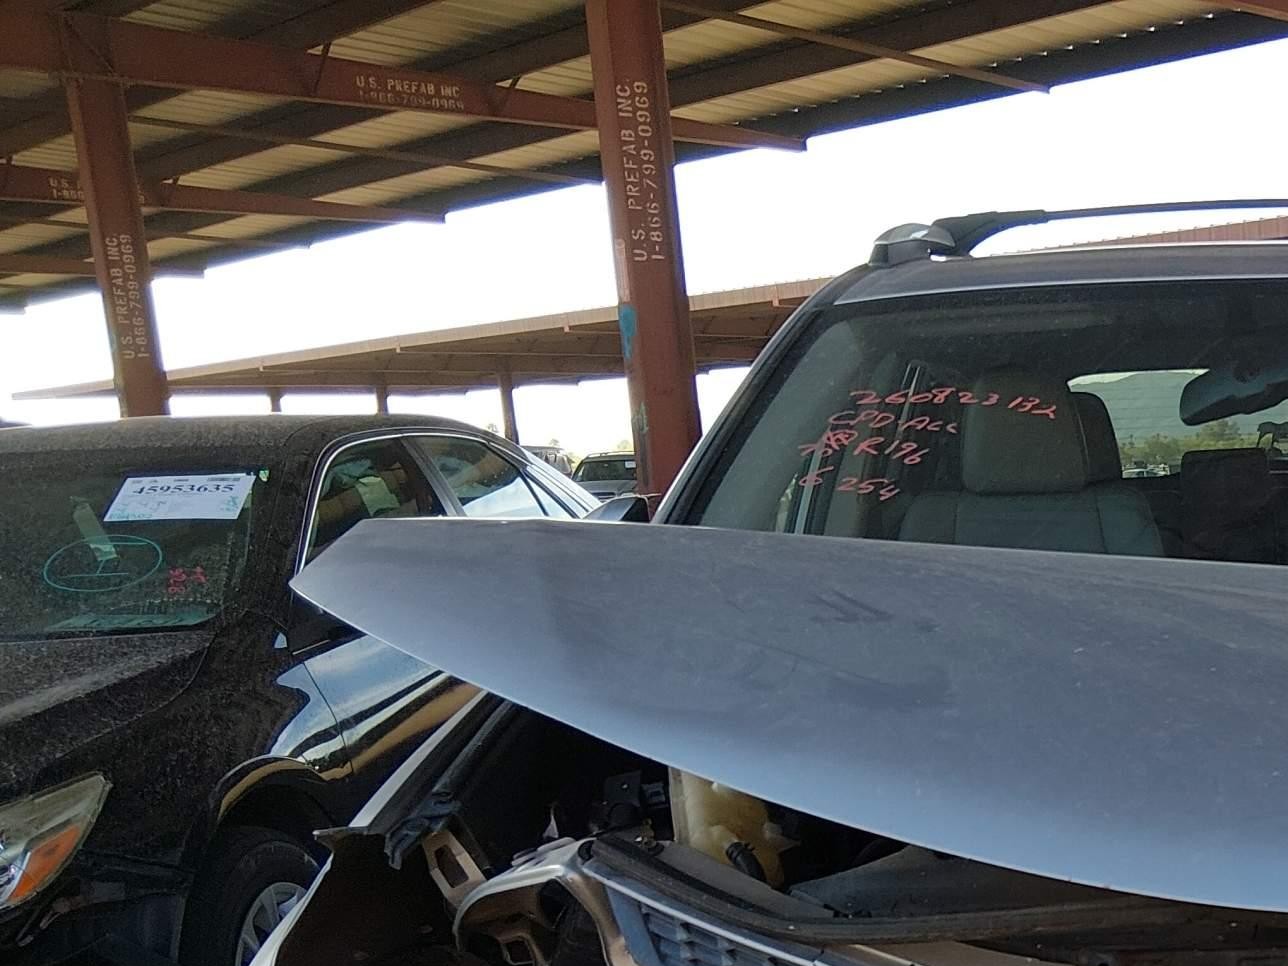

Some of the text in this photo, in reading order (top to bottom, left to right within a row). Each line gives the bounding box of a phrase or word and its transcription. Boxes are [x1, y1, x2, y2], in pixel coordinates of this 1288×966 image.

[387, 79, 435, 95] PREFAB
[621, 129, 643, 210] PREFAB
[633, 81, 665, 260] 1-866-799-0969
[632, 223, 648, 262] U.S.
[110, 267, 131, 324] PREFAB
[132, 483, 236, 496] 45953635
